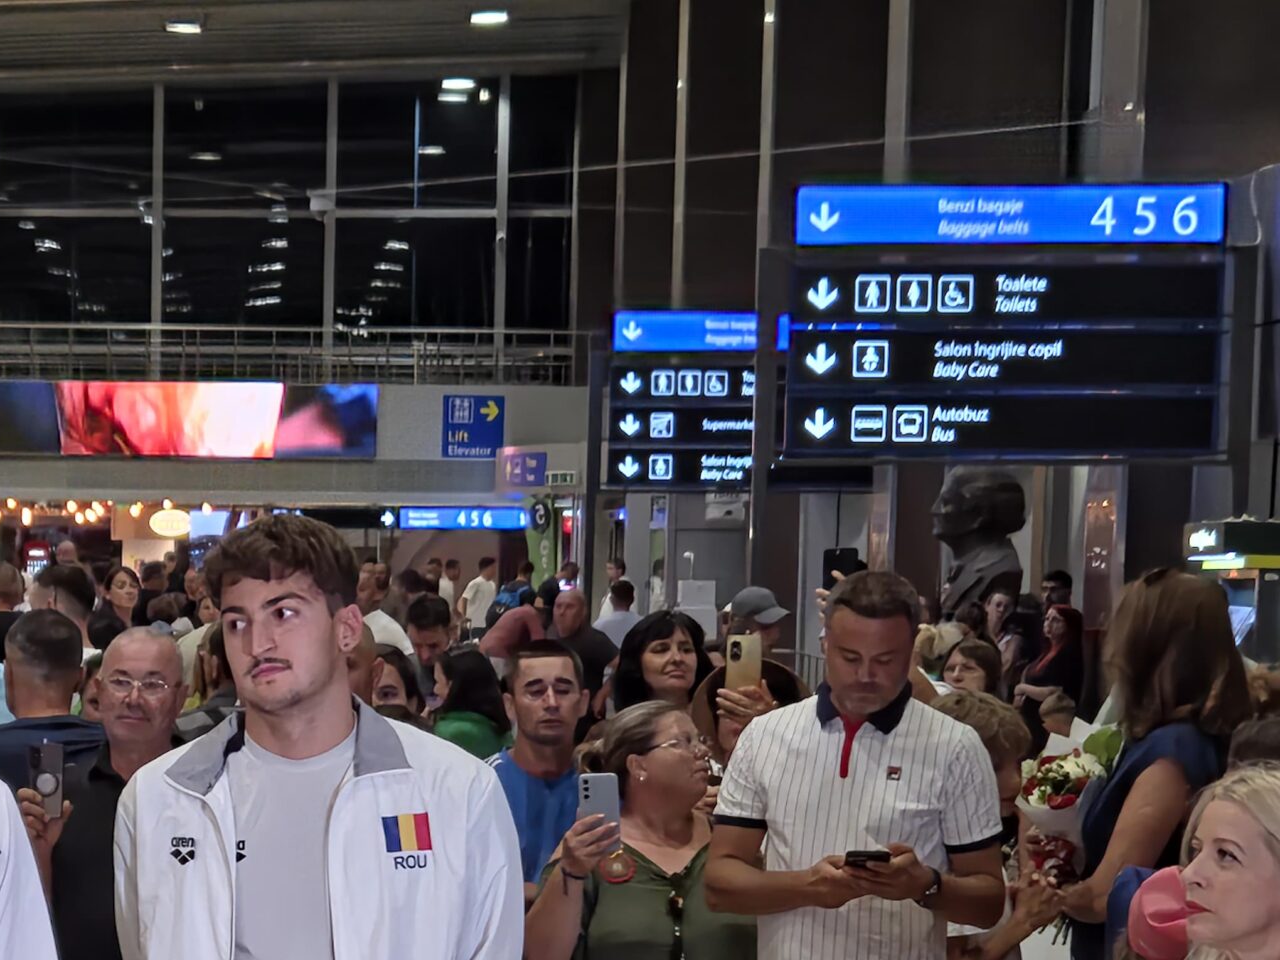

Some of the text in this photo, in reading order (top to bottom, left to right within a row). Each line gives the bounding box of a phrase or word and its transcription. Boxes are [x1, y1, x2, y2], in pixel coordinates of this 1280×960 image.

[1090, 195, 1198, 236] 4 5 6
[938, 219, 997, 239] Baggage
[995, 274, 1048, 292] Toalete
[995, 294, 1038, 312] Toilets
[934, 340, 972, 357] Salon
[933, 361, 999, 381] Baby Care
[932, 405, 990, 422] Autobuz
[448, 430, 468, 442] Lift
[931, 425, 956, 442] Bus
[448, 445, 491, 456] Elevator
[457, 511, 466, 527] 4
[471, 511, 479, 527] 5
[483, 511, 493, 527] 6
[393, 854, 427, 870] ROU
